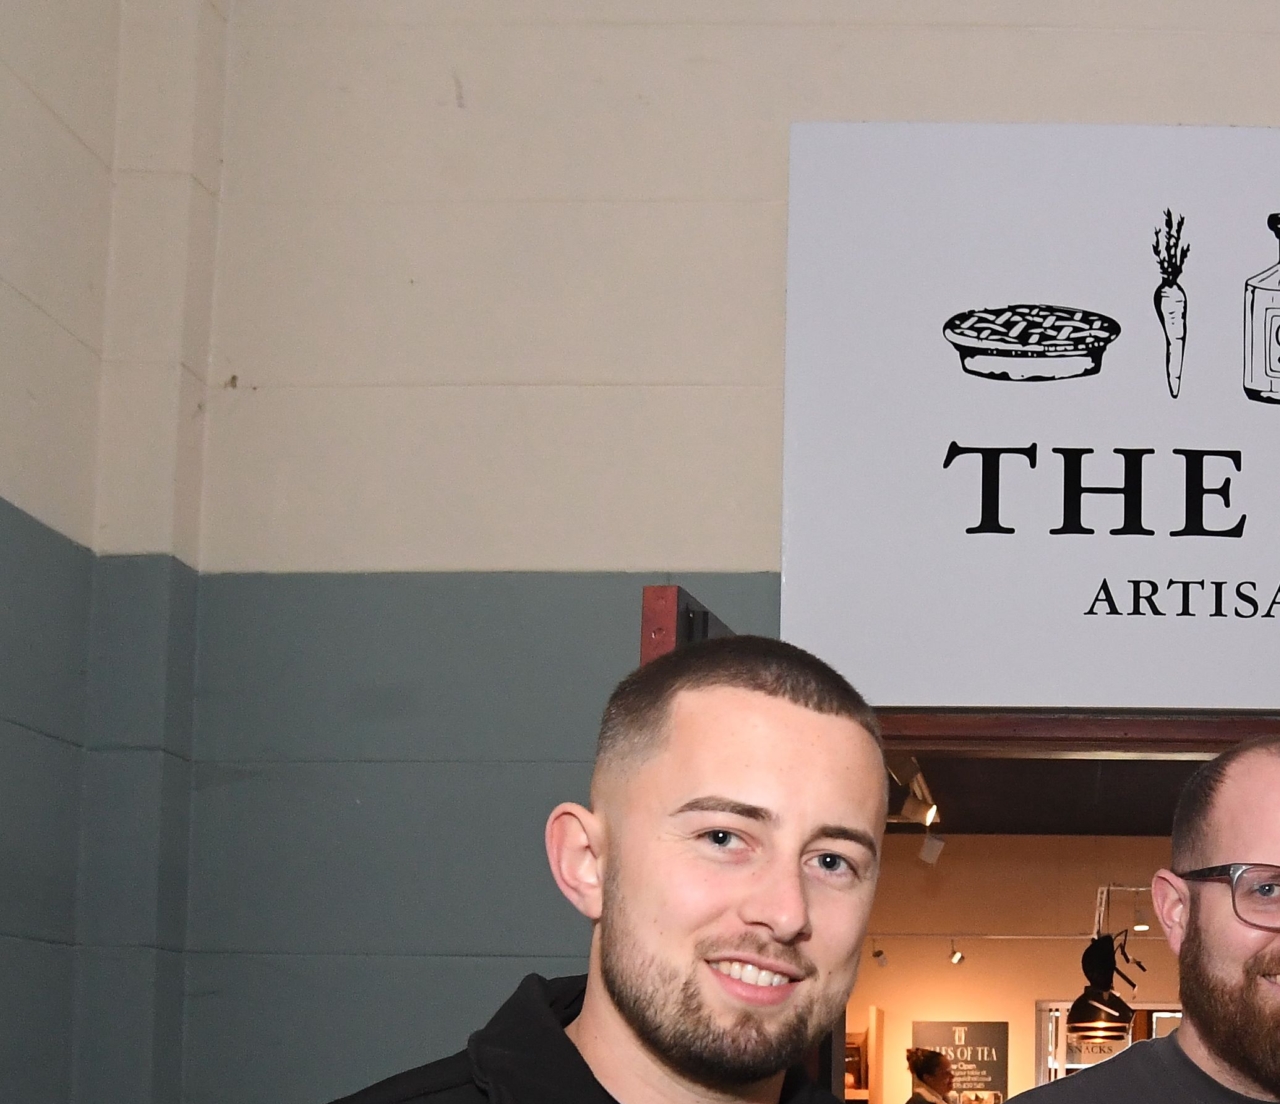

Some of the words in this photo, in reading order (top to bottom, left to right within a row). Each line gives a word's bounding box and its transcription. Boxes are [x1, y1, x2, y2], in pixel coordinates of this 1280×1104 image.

[943, 442, 1246, 539] THE
[957, 1047, 973, 1060] OF
[976, 1046, 997, 1061] TEA
[1067, 1045, 1113, 1054] SNACKS
